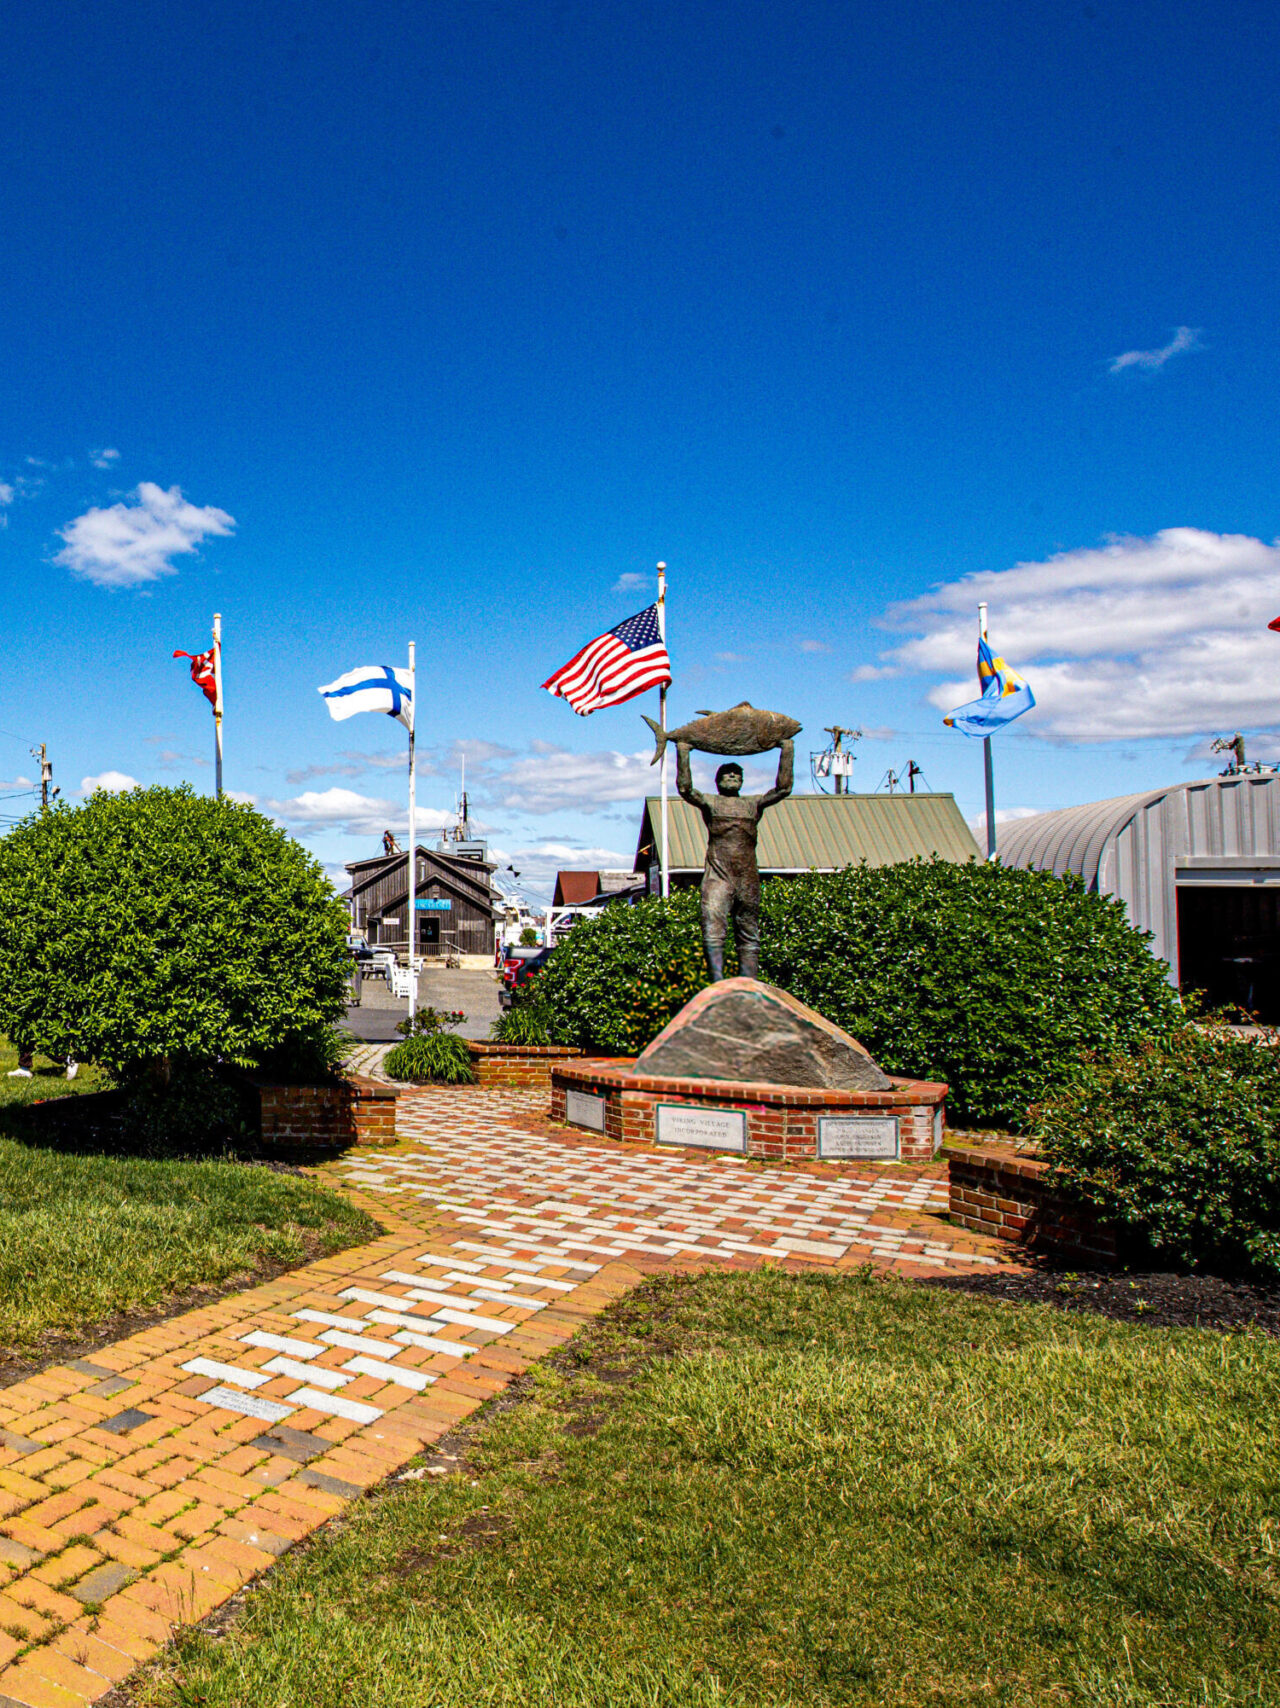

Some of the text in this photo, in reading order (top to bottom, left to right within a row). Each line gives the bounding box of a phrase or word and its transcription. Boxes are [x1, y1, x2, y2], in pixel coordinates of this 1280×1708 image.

[671, 1116, 730, 1128] VIKING VILLAGE
[674, 1127, 728, 1137] INCORPORATED
